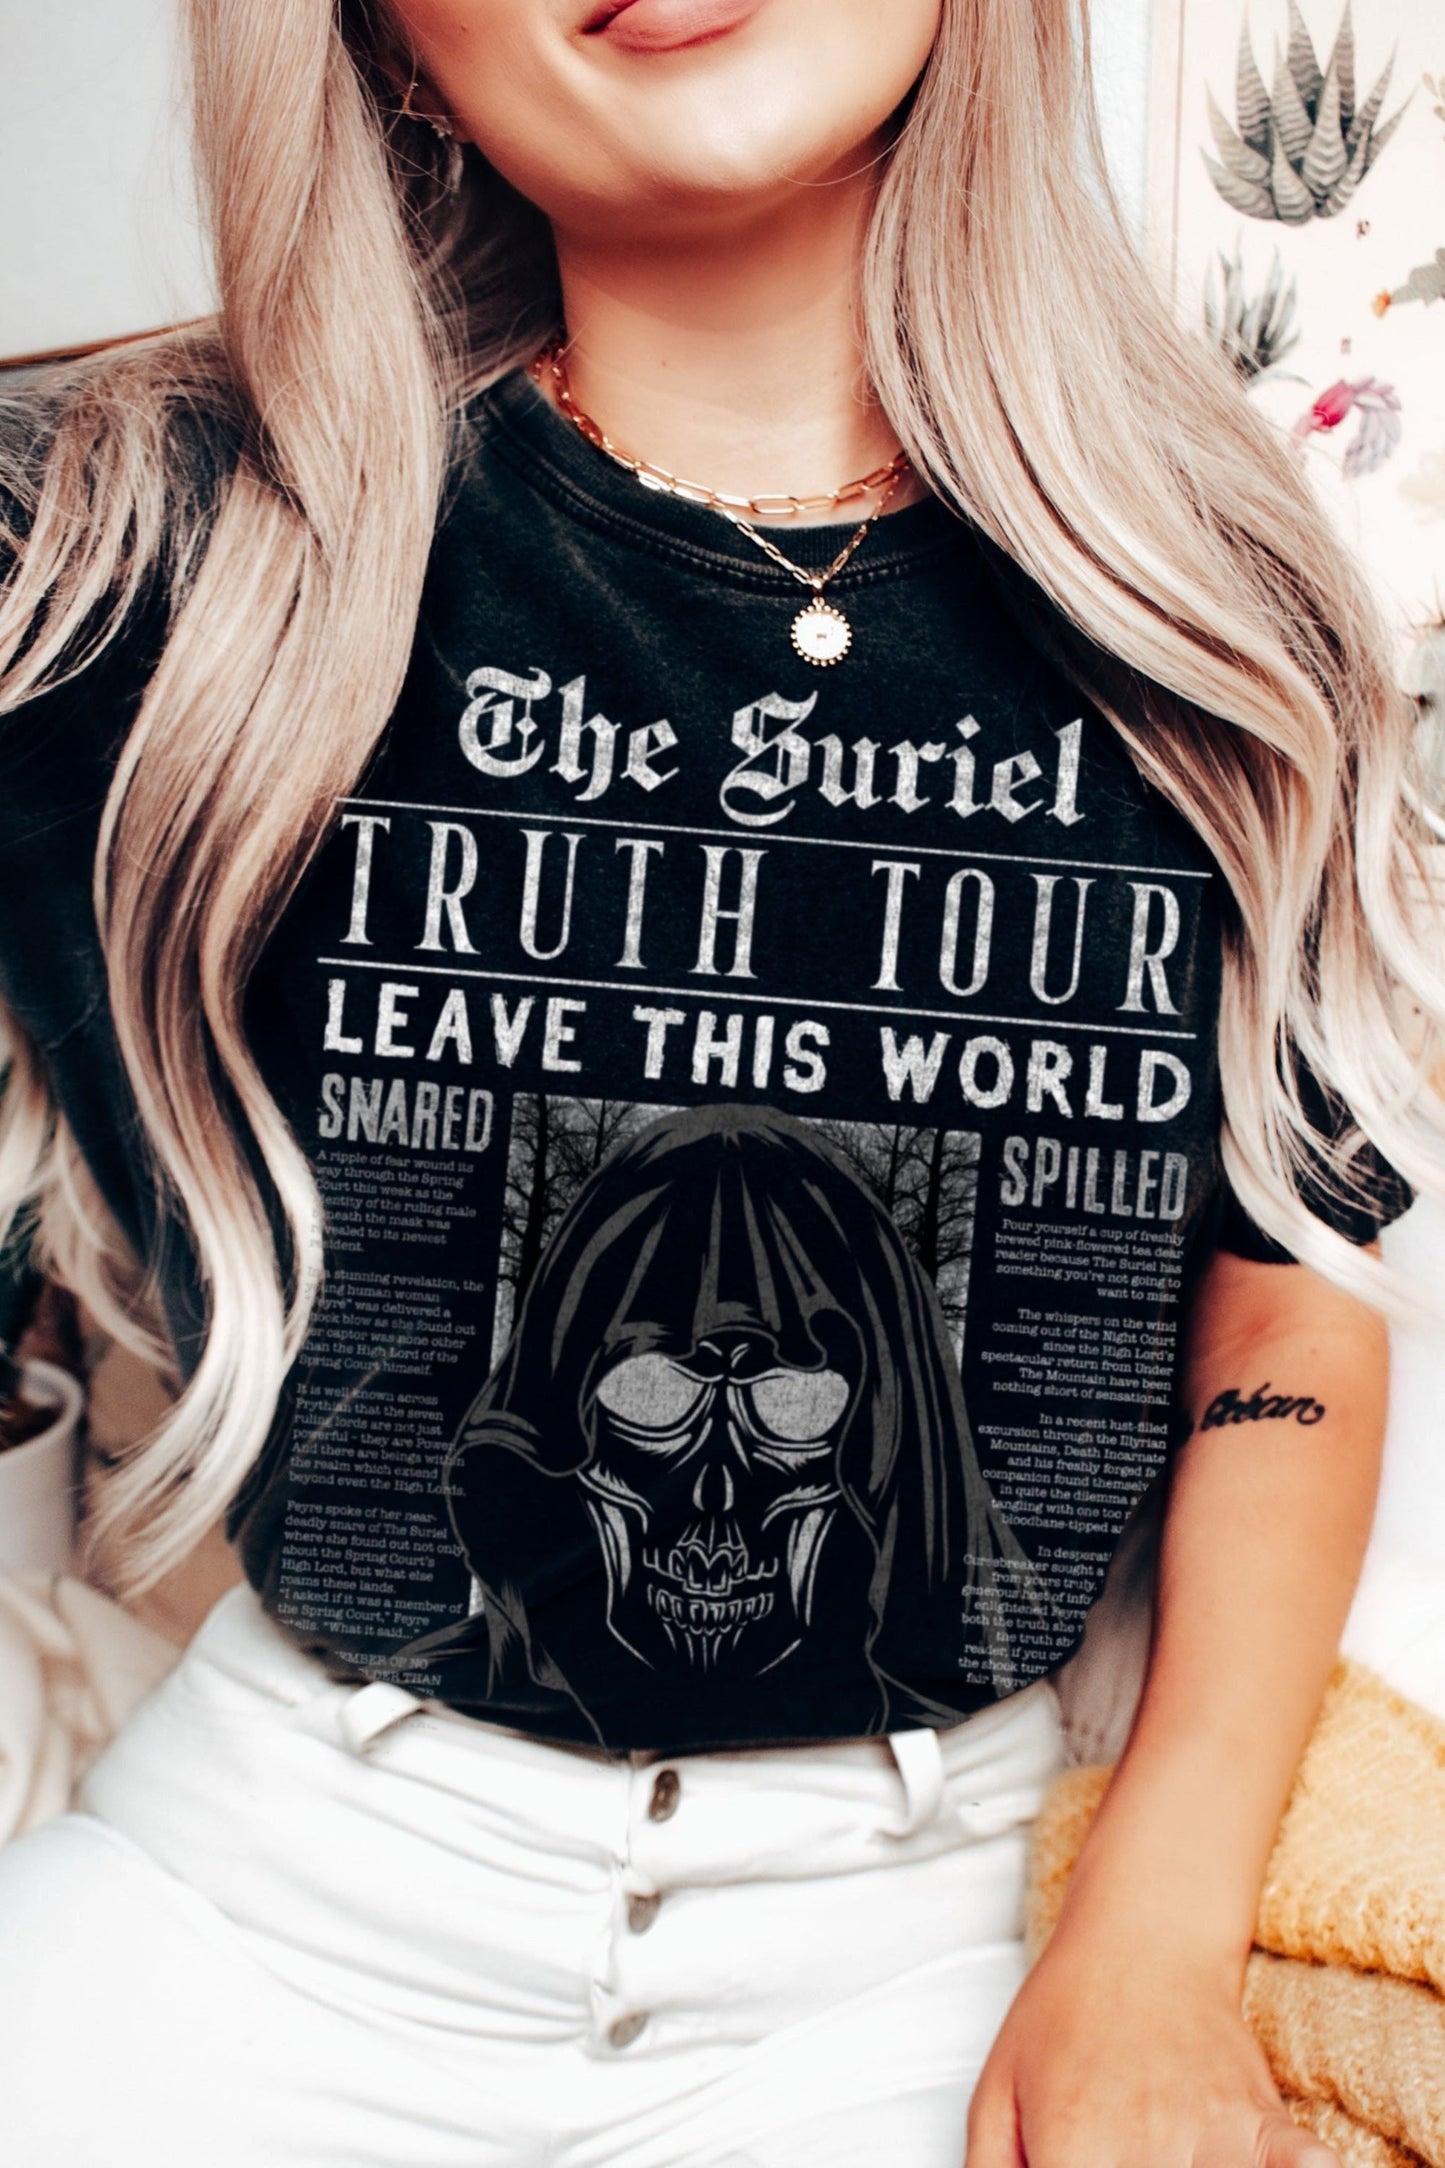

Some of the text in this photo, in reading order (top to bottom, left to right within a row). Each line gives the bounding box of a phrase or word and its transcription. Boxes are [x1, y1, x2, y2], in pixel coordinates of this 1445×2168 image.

[458, 664, 1086, 826] The Suriel
[339, 814, 1183, 1014] TRUTH TOUR
[322, 978, 1192, 1122] LEAVE THIS WORLD
[317, 1073, 494, 1152] SNARED
[1000, 1136, 1188, 1220] SPILLED
[1003, 1219, 1032, 1231] Pour
[1036, 1222, 1088, 1235] yourself
[1100, 1230, 1122, 1241] cup
[995, 1233, 1040, 1246] brewed
[1132, 1245, 1151, 1255] tea
[1155, 1246, 1184, 1258] dear
[995, 1250, 1182, 1273] reader because The Suriel has
[1108, 1272, 1128, 1283] not
[1097, 1288, 1128, 1298] want
[1018, 1308, 1176, 1332] The whispers on wind
[992, 1323, 1038, 1337] coming
[1041, 1325, 1061, 1336] out
[1064, 1327, 1078, 1337] of
[1080, 1329, 1099, 1340] the
[1103, 1331, 1137, 1344] Night
[1043, 1341, 1075, 1351] since
[1103, 1345, 1131, 1359] High
[1057, 1358, 1098, 1369] return
[1102, 1360, 1131, 1373] from
[1135, 1364, 1173, 1376] Under
[993, 1381, 1041, 1396] nothing
[1044, 1385, 1078, 1397] short
[1019, 1367, 1171, 1390] The Mountain have been
[1039, 1414, 1052, 1425] In
[1066, 1418, 1106, 1429] recent
[1043, 1429, 1093, 1444] through
[1120, 1435, 1166, 1449] Illyrian
[1064, 1445, 1100, 1458] Death
[1008, 1456, 1031, 1467] and
[1034, 1457, 1053, 1469] his
[1103, 1463, 1142, 1478] forged
[1054, 1474, 1088, 1486] found
[1000, 1485, 1012, 1495] in
[1015, 1487, 1048, 1501] quite
[1050, 1488, 1070, 1500] the
[1073, 1491, 1127, 1505] dilemma
[1046, 1504, 1073, 1516] with
[1077, 1509, 1099, 1518] one
[1102, 1509, 1121, 1519] too
